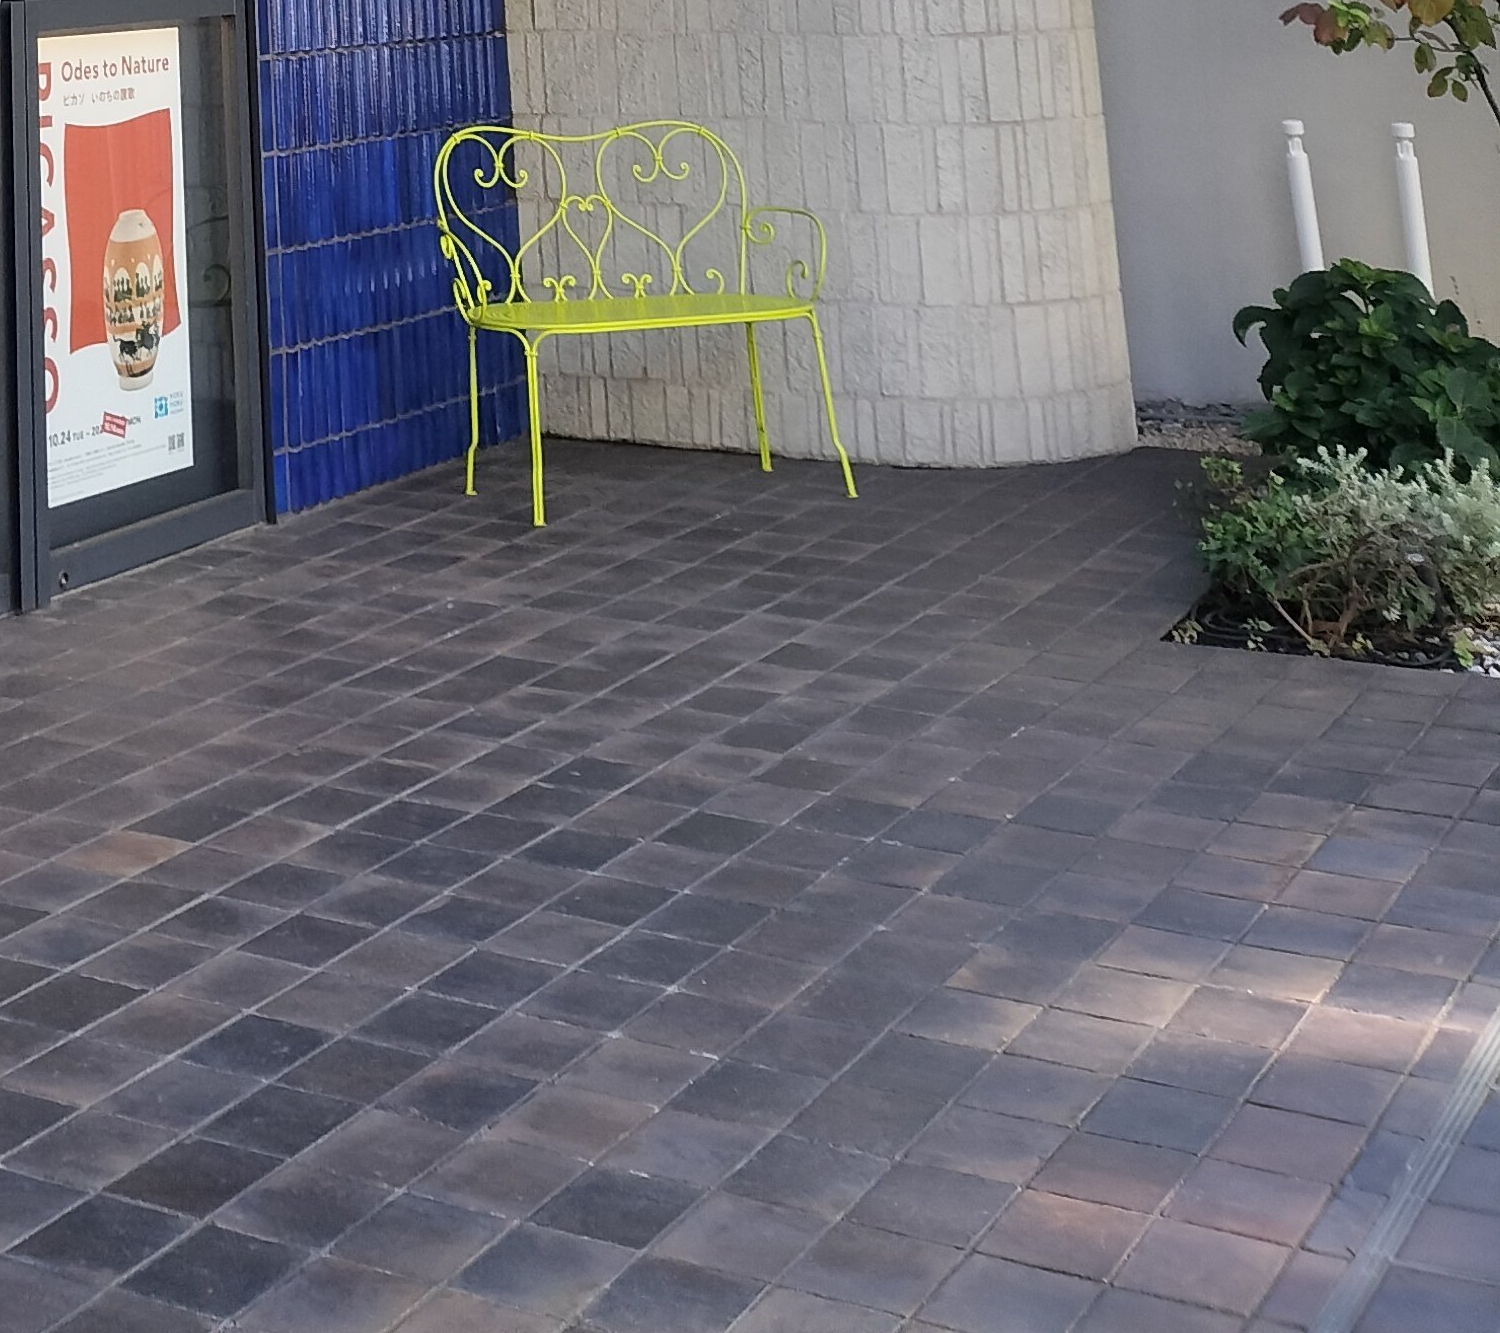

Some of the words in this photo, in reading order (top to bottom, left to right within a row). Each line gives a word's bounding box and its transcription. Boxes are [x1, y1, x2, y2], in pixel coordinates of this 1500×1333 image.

[61, 58, 99, 82] Odes
[103, 59, 117, 78] to
[121, 55, 169, 76] Nature
